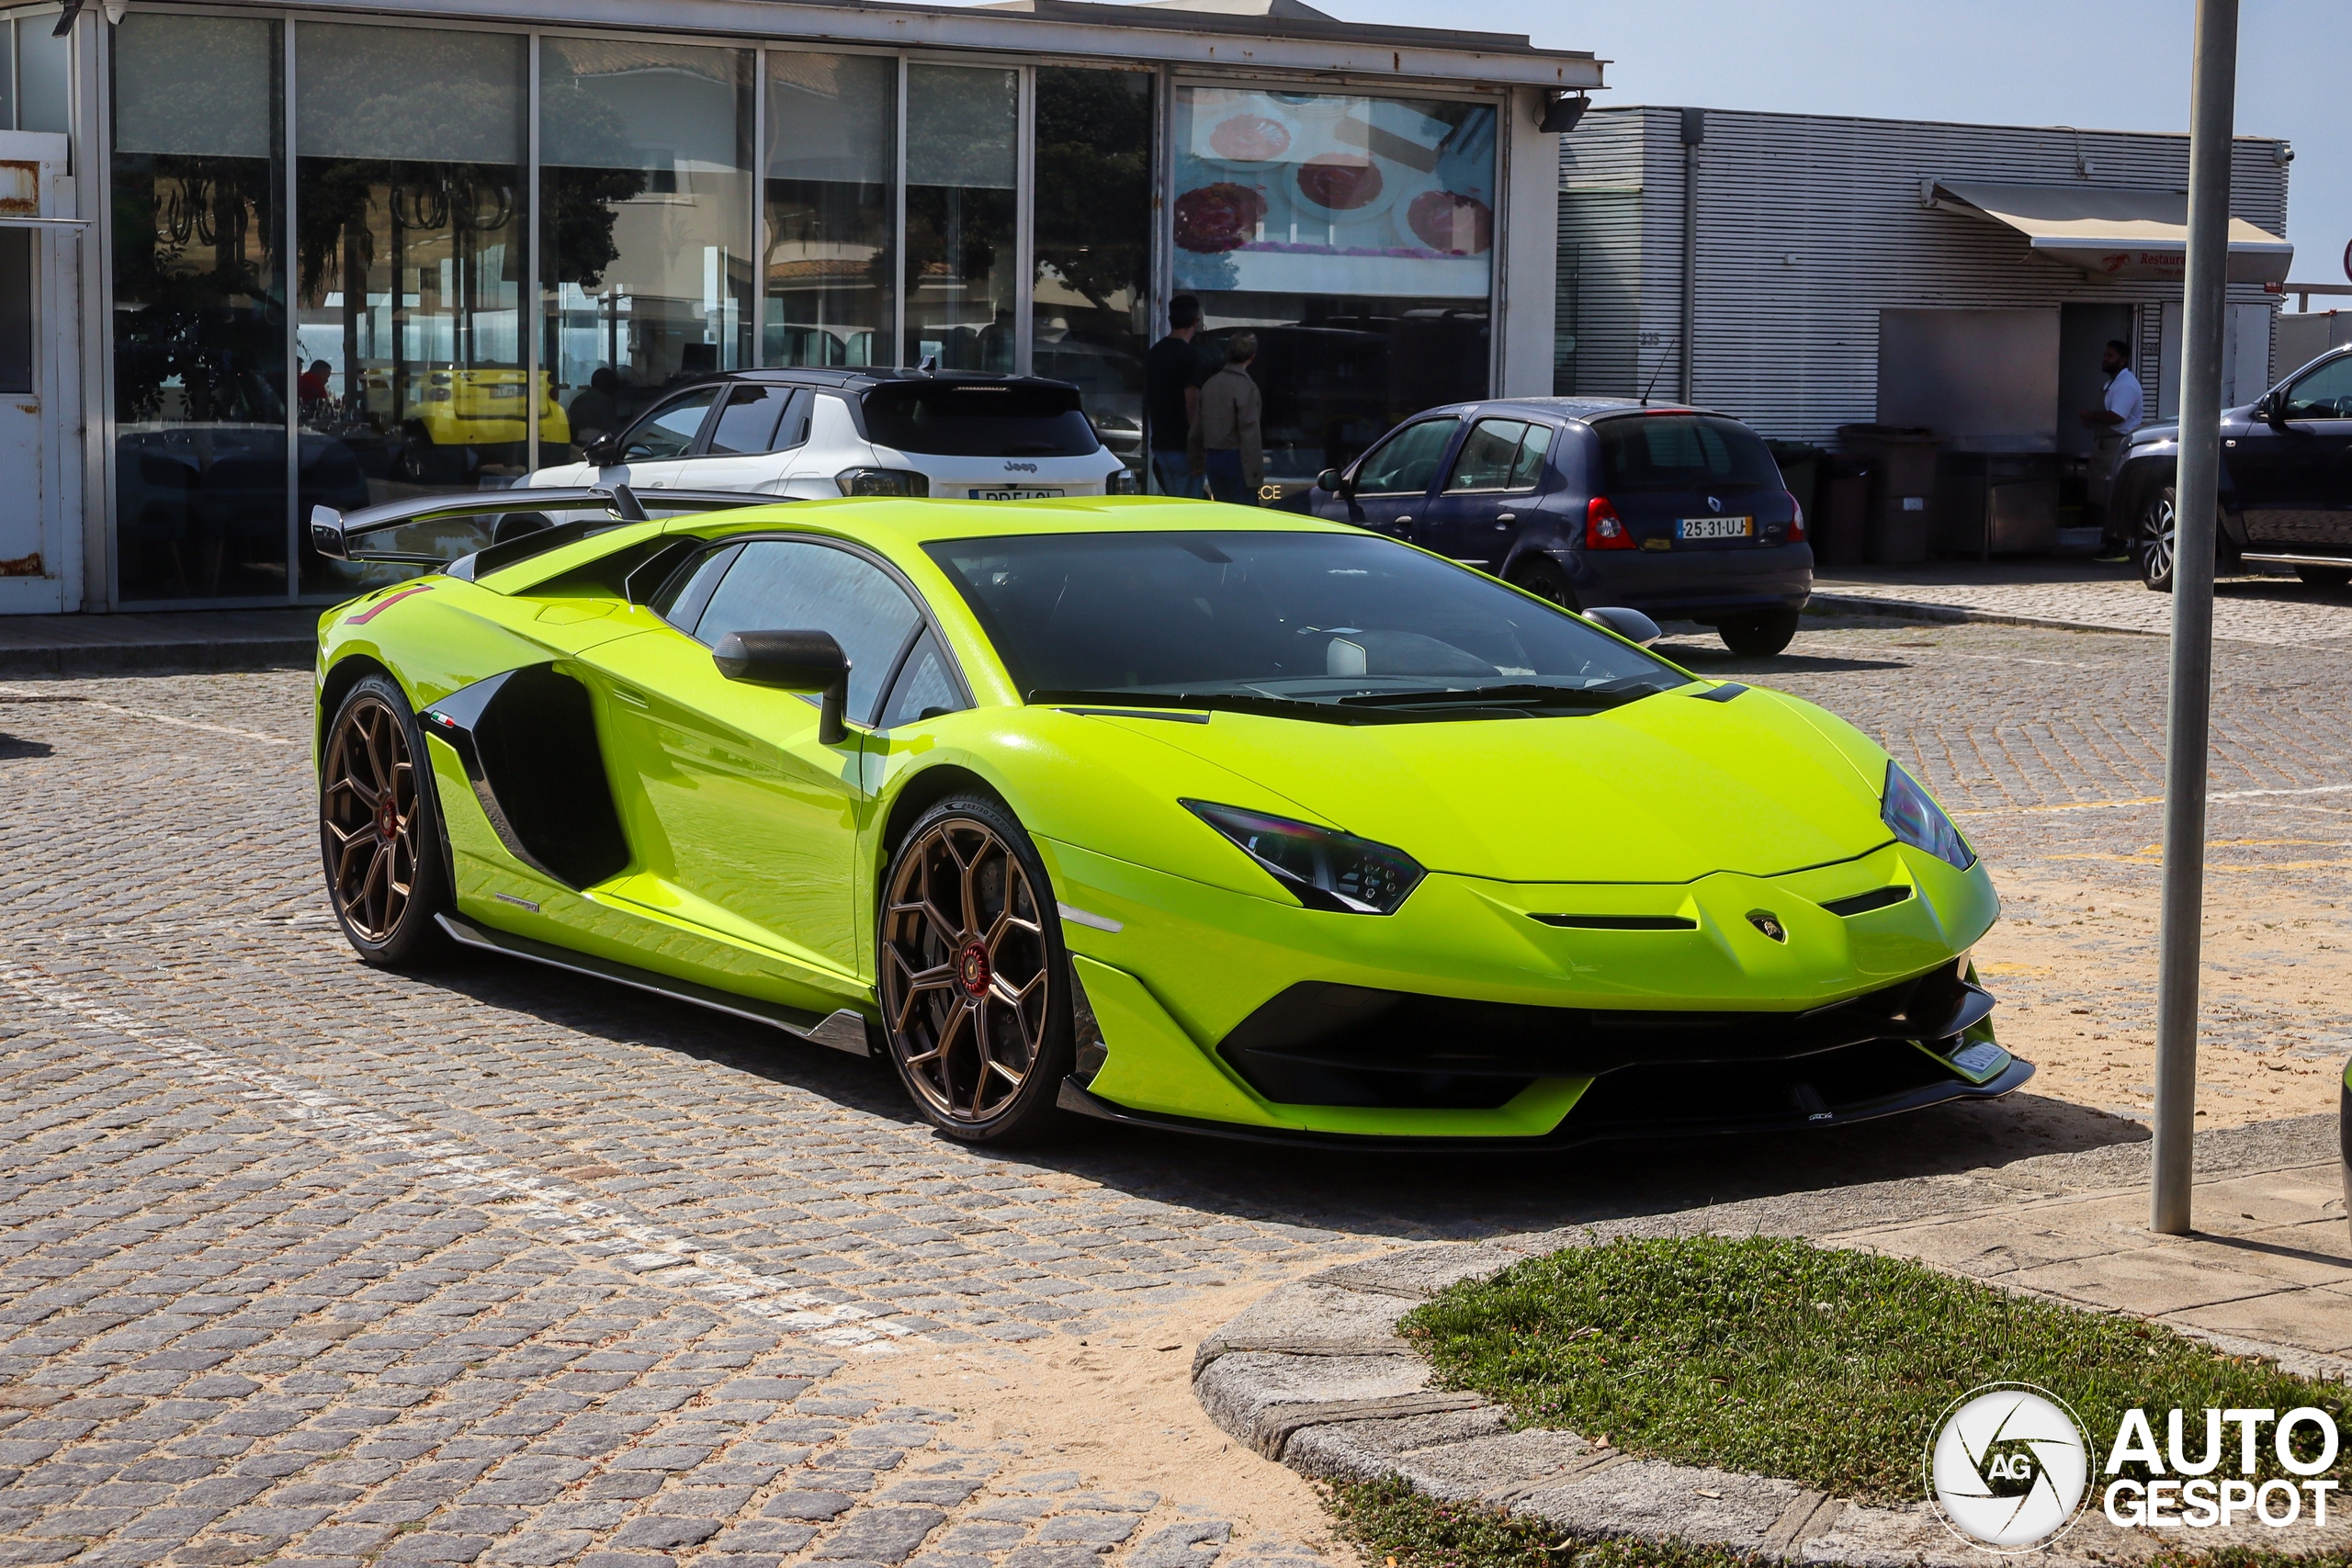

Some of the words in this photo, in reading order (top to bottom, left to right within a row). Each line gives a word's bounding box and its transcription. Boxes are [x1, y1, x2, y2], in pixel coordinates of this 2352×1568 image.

[1004, 460, 1037, 474] Jeep
[1258, 485, 1282, 500] CE
[961, 803, 989, 815] 255/30
[989, 813, 1011, 832] ZR20
